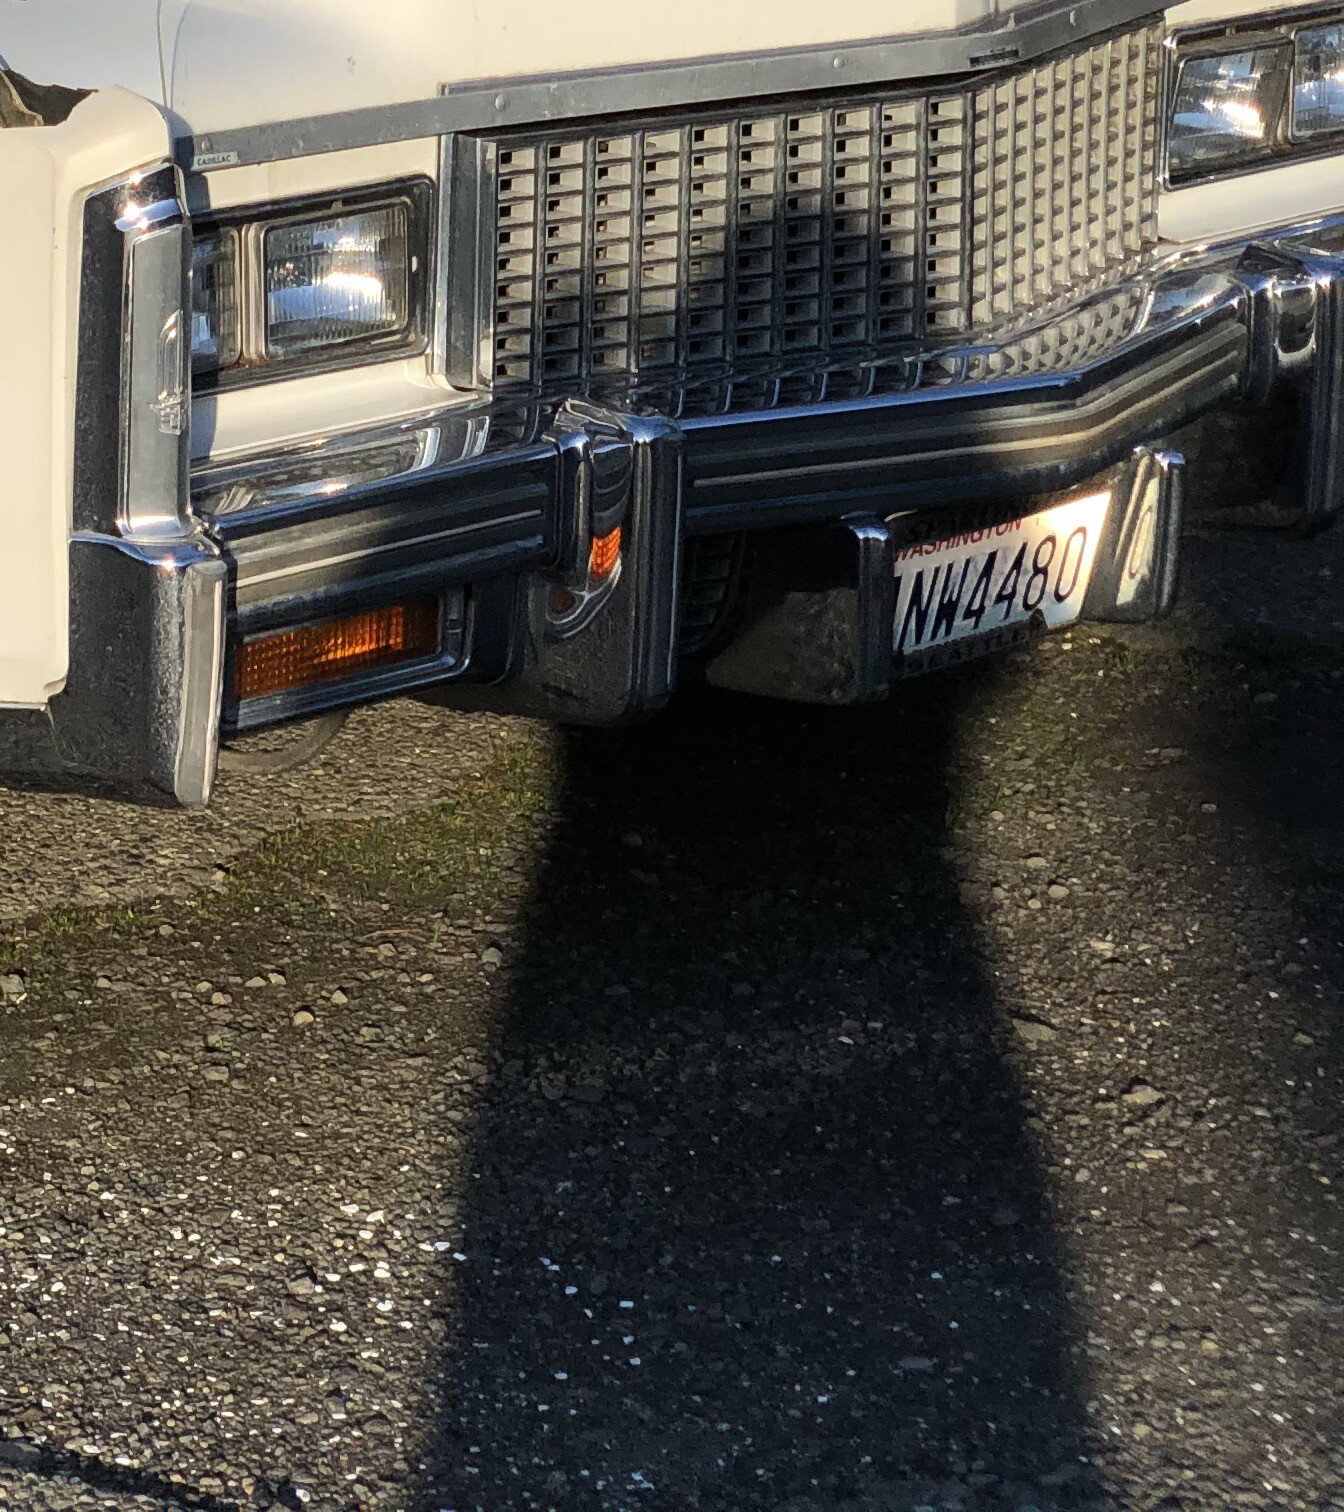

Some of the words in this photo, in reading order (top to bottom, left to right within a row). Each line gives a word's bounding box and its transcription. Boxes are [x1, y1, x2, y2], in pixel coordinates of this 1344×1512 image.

[197, 155, 230, 166] CADILLAC
[893, 518, 1023, 562] WASHINGTON
[893, 526, 1087, 651] NW4480
